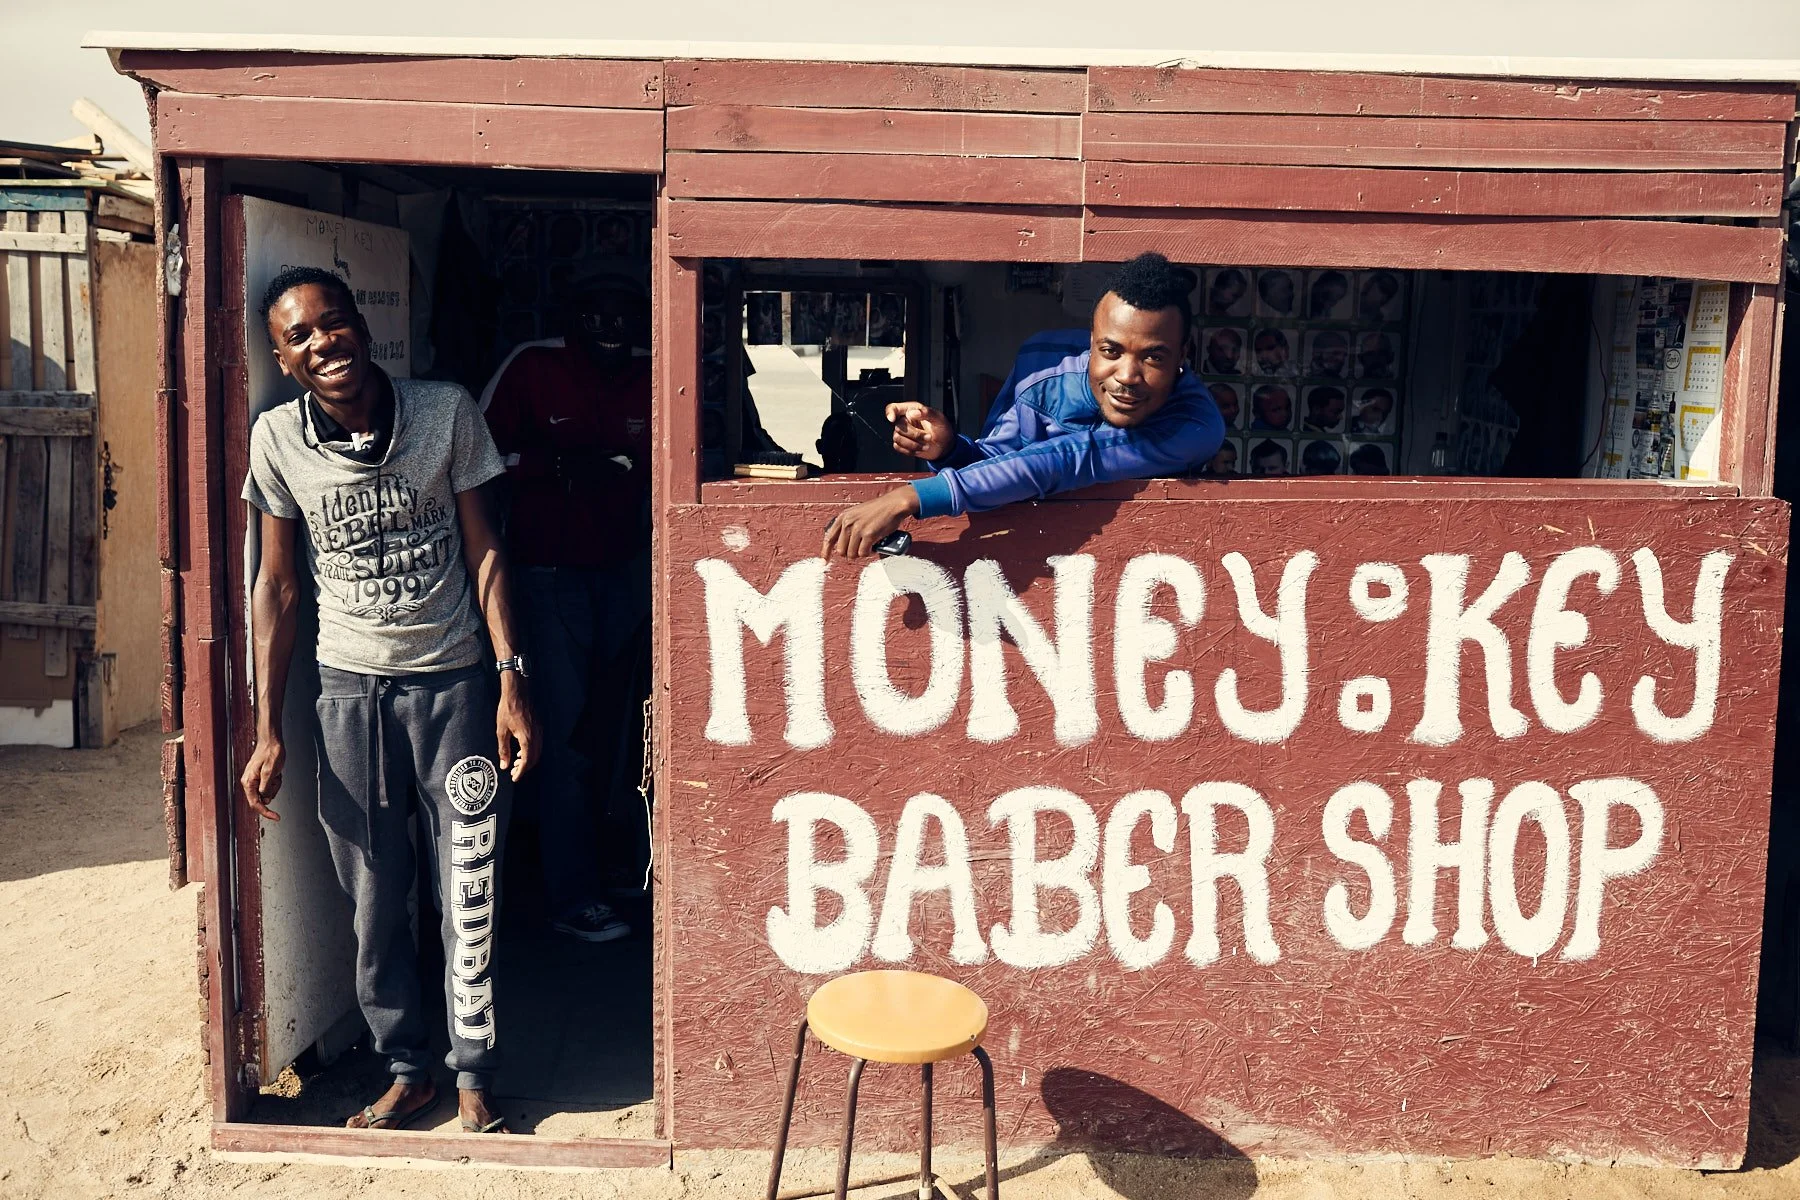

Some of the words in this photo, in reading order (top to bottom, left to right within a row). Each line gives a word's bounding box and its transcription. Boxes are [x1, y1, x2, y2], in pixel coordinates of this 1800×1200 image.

[306, 216, 347, 241] MONEY
[354, 231, 373, 251] KEY
[410, 506, 448, 530] MARK
[353, 575, 421, 606] 1999
[766, 782, 1281, 974] BABER
[1322, 777, 1666, 963] SHOP
[451, 813, 496, 1050] REDBAT
